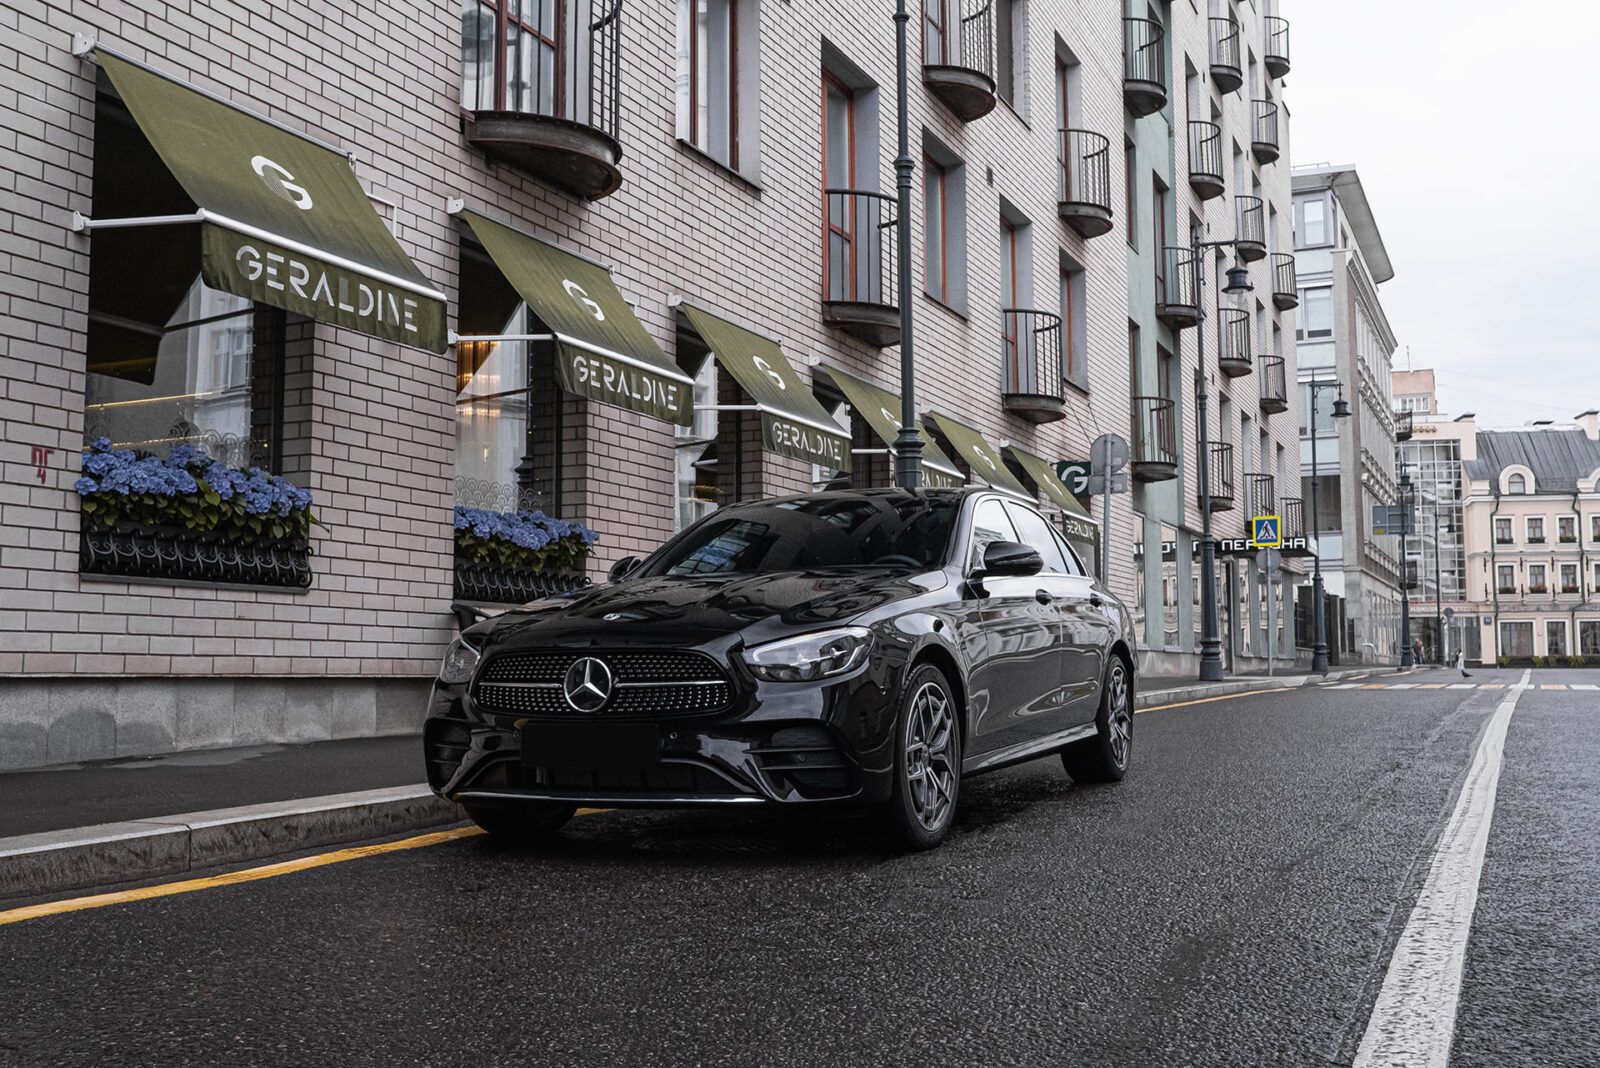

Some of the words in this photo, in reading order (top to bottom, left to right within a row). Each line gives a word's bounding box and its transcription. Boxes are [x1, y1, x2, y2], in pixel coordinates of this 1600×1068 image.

[235, 245, 418, 333] GERALDINE
[573, 355, 678, 411] GERALDINE
[772, 421, 842, 461] GERALDINE
[1061, 465, 1089, 494] G
[1221, 538, 1306, 551] ПЕРНА
